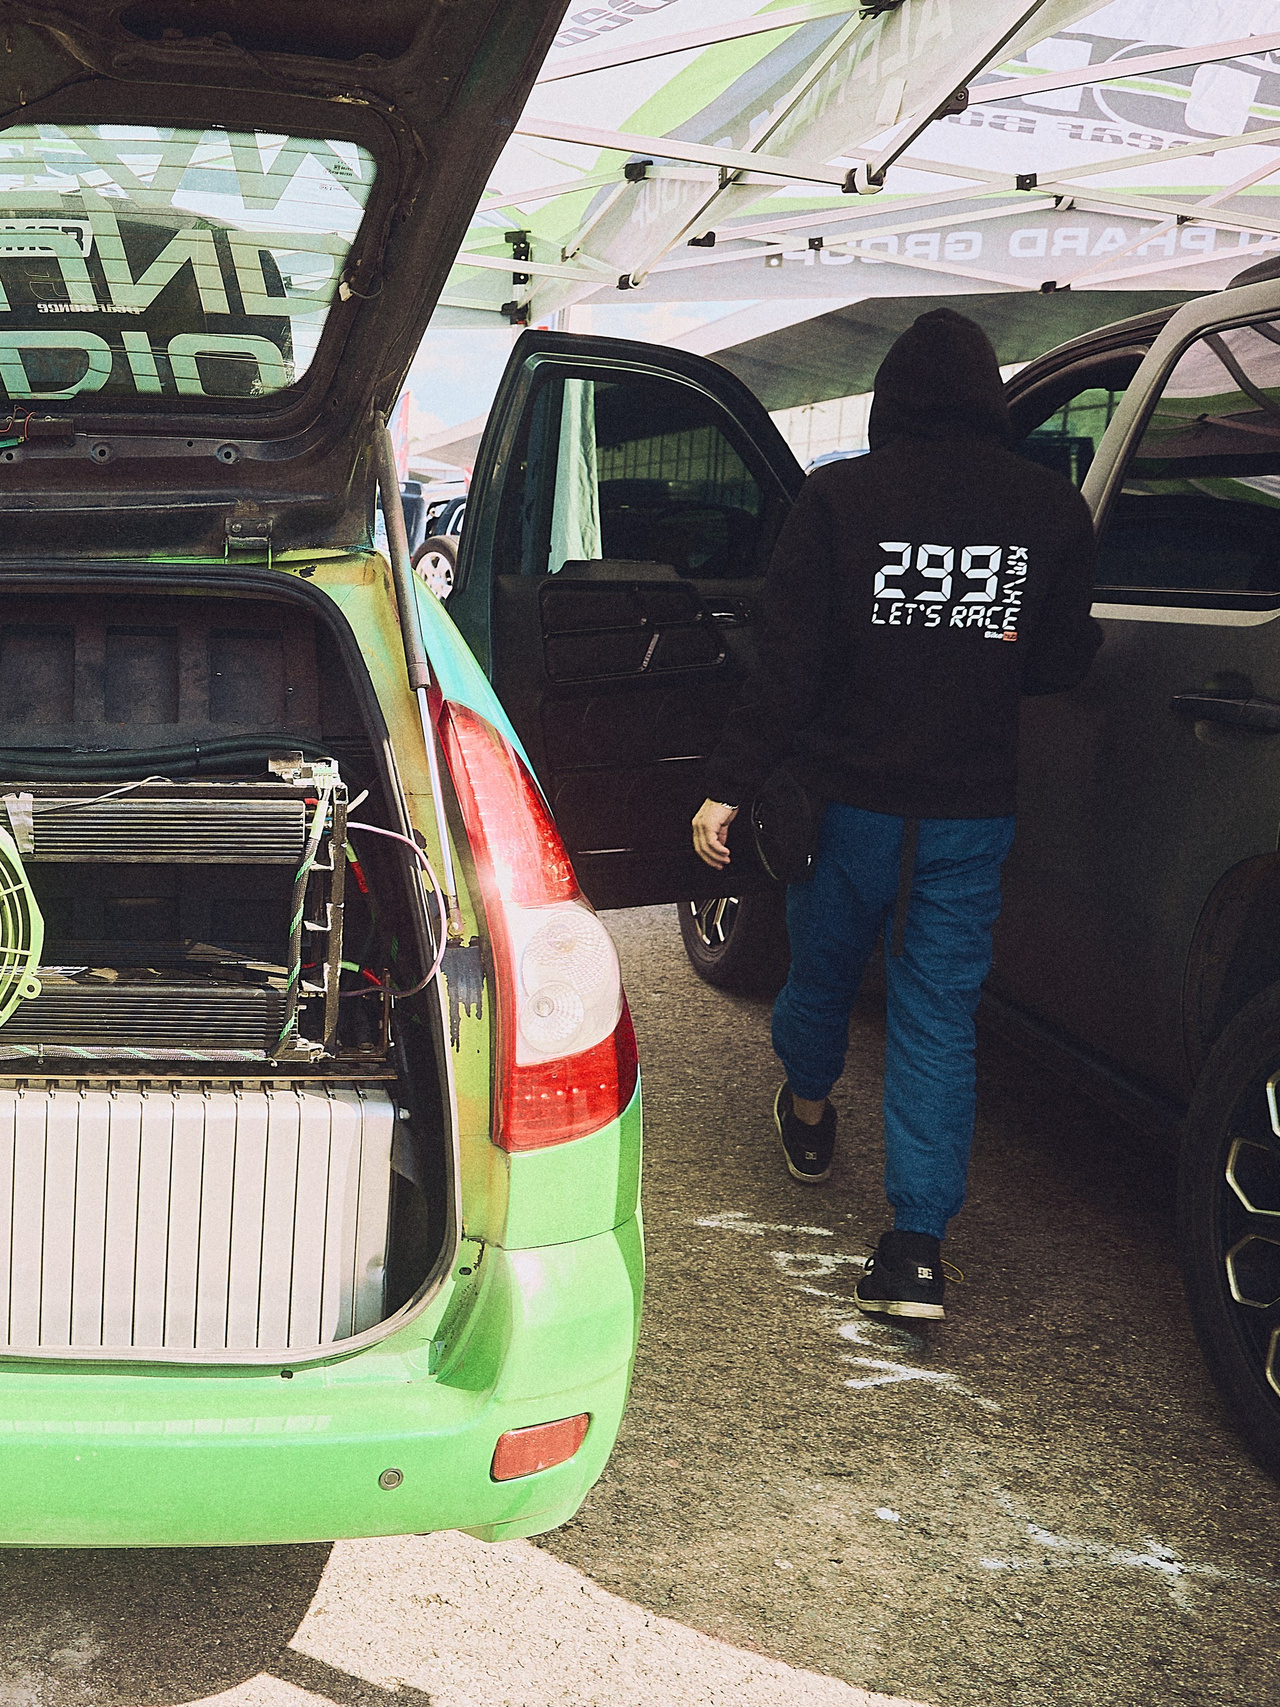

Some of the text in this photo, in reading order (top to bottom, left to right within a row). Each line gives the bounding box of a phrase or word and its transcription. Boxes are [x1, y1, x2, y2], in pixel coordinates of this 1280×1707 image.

[873, 541, 1003, 603] 299
[871, 602, 1022, 631] LET'S RACE
